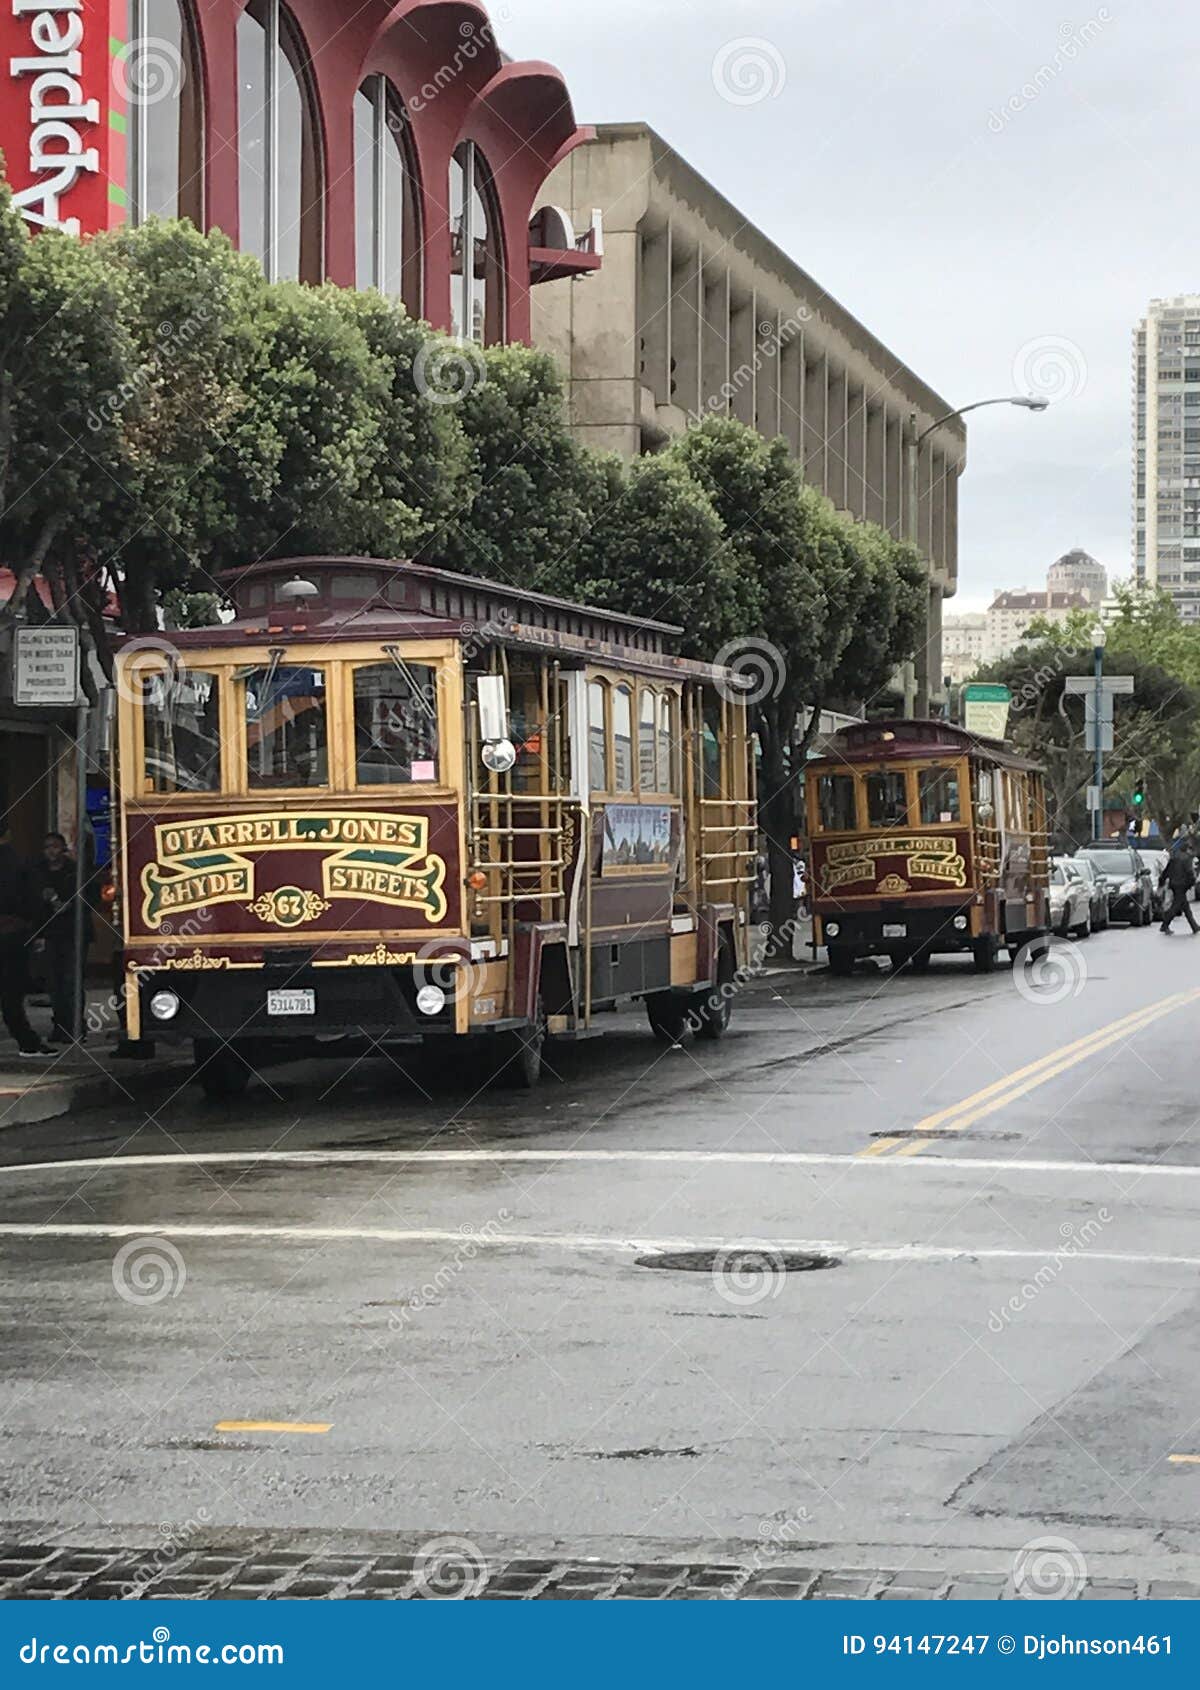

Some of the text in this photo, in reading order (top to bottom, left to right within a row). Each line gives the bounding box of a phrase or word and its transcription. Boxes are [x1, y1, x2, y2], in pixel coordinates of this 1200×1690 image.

[321, 819, 418, 845] JONES
[159, 868, 429, 906] &HYDE STREETS
[277, 895, 301, 916] 67
